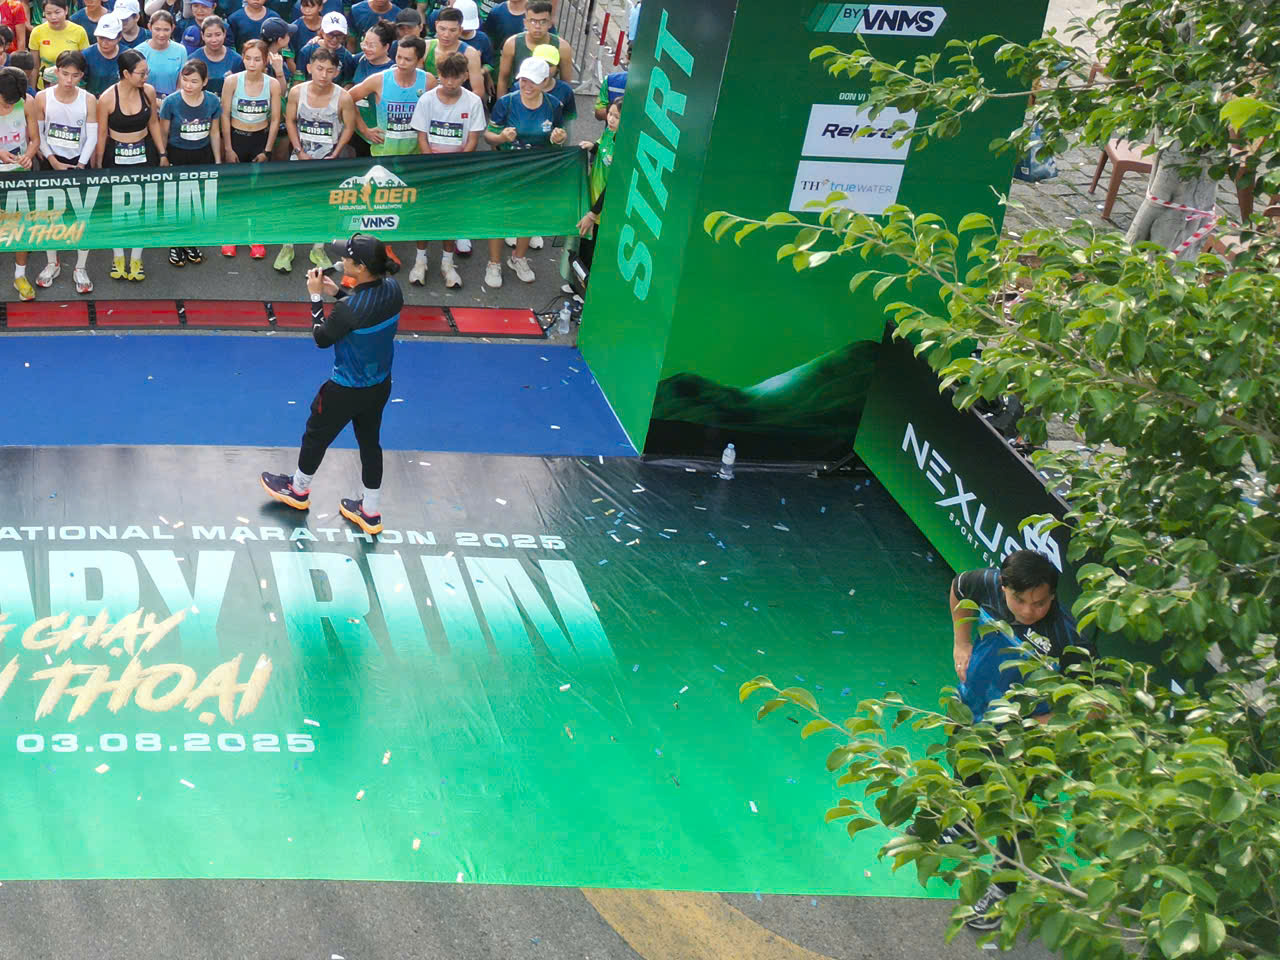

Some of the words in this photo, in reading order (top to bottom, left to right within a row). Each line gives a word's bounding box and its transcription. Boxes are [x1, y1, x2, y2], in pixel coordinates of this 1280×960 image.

[843, 8, 861, 19] BY
[863, 9, 936, 33] VNMS
[617, 8, 695, 301] START
[86, 173, 173, 185] MARATHON
[179, 171, 219, 180] 2025
[801, 180, 820, 191] TH
[111, 179, 218, 224] RUN
[328, 190, 358, 204] BA
[375, 188, 417, 204] DEN
[361, 216, 395, 228] VNMS
[190, 525, 437, 545] MARATHON
[454, 532, 567, 551] 2025
[949, 512, 979, 549] SPORT
[17, 732, 317, 753] 03.08.2025
